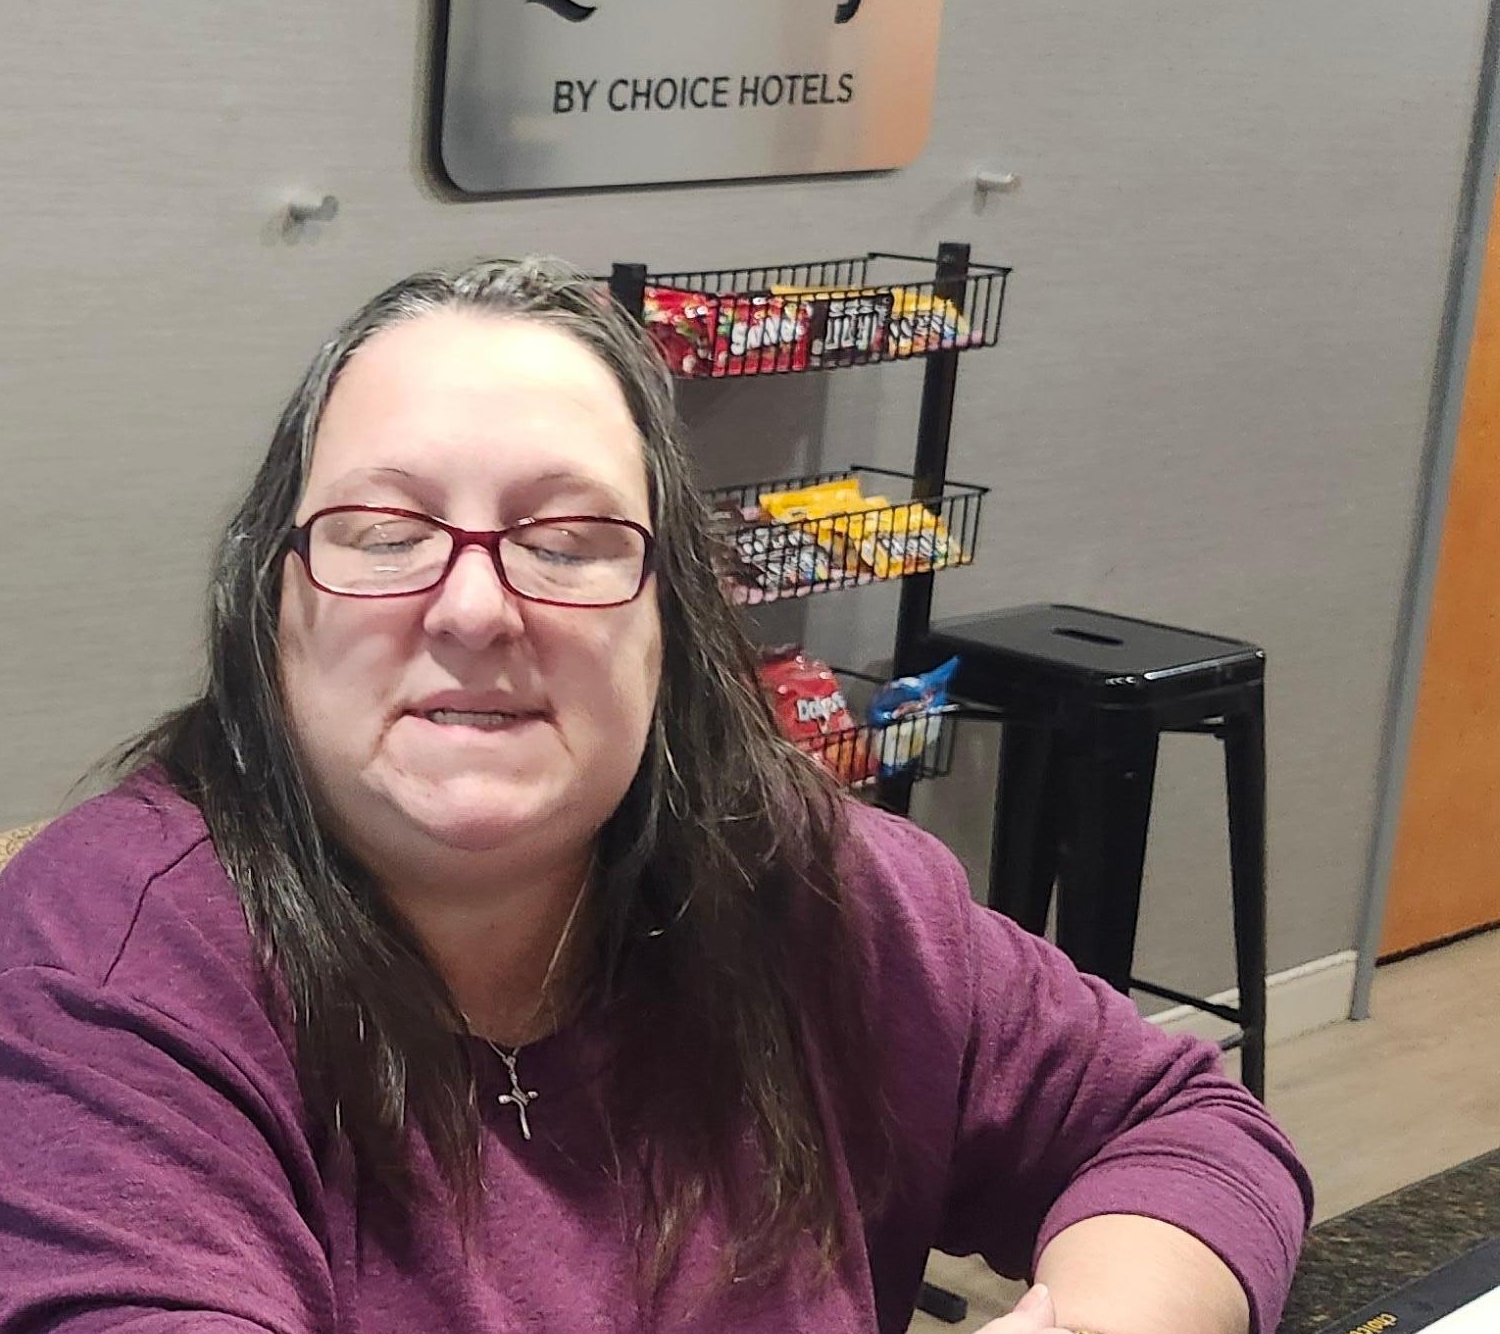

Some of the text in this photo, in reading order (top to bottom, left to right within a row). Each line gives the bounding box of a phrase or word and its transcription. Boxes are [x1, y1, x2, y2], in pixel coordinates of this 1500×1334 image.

[553, 73, 854, 114] BY CHOICE HOTELS
